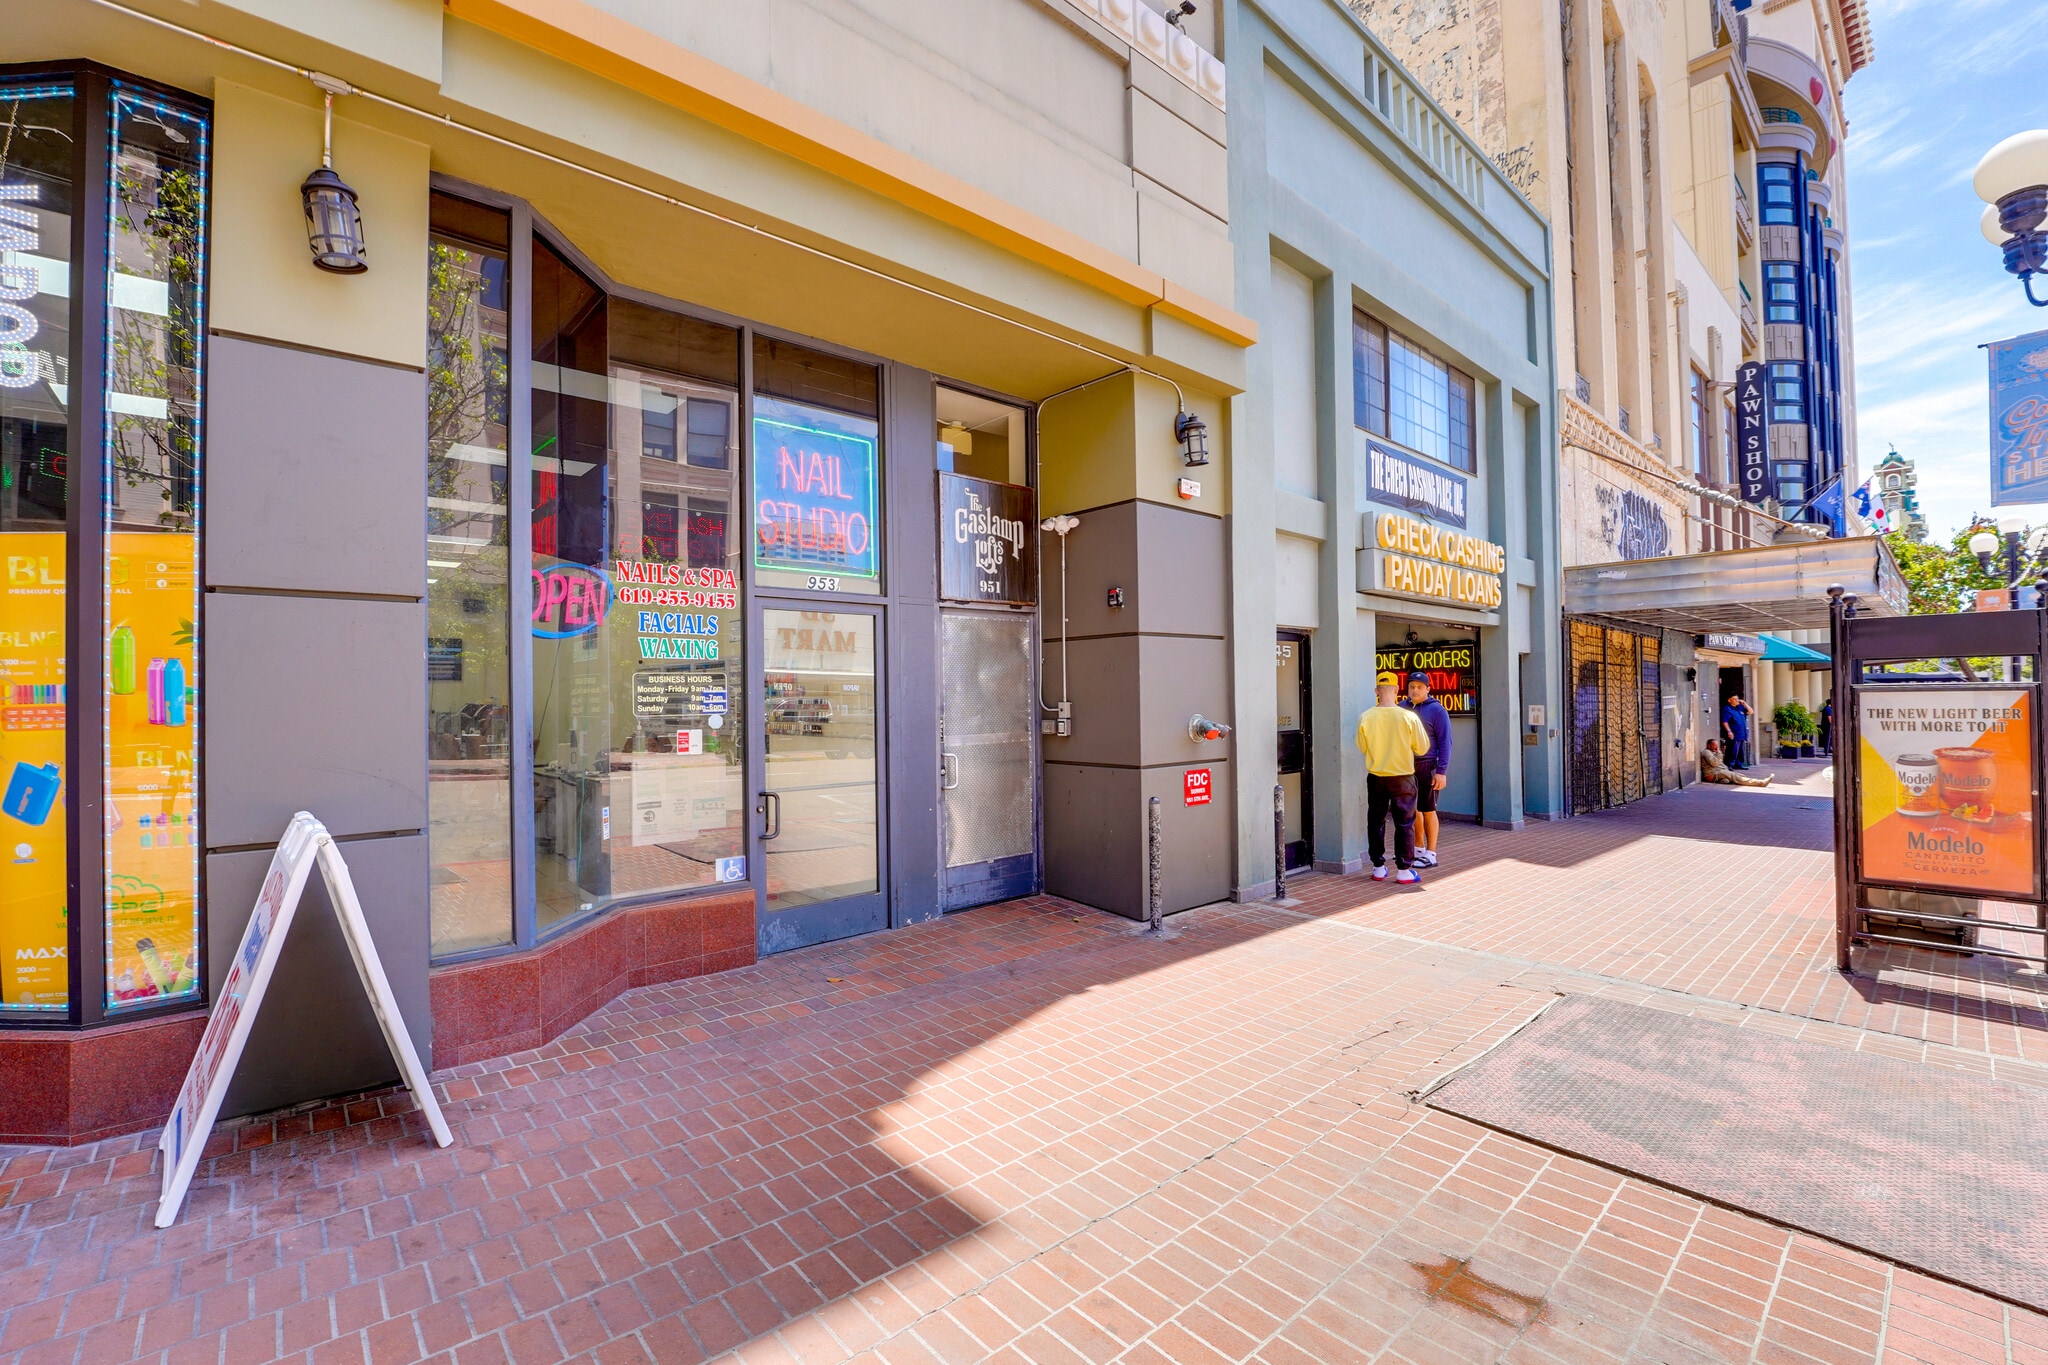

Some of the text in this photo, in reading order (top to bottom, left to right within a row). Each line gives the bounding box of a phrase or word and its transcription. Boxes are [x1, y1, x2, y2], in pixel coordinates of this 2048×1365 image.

[1741, 368, 1760, 429] PAWN
[781, 446, 853, 500] NAIL
[1745, 435, 1764, 498] SHOP
[1370, 449, 1384, 490] THE
[1385, 455, 1408, 498] CHECK
[1408, 464, 1436, 507] CASHING
[964, 487, 983, 512] The
[759, 499, 868, 555] STUDIO
[955, 507, 1025, 560] Gaslamp
[1378, 512, 1505, 574] CHECK CASHING
[975, 535, 1004, 574] Lofts
[616, 561, 737, 589] NAILS & SPA
[808, 576, 836, 591] 953
[1386, 555, 1502, 607] PAYDAY LOANS
[532, 569, 606, 626] OPEN
[619, 587, 737, 609] 619-255-9455
[980, 580, 1000, 594] 951
[638, 611, 718, 635] FACIALS
[638, 637, 719, 660] WAXING
[1709, 634, 1723, 645] PAWN
[1723, 635, 1738, 647] SHOP
[1376, 649, 1470, 670] ONEY ORDERS
[1427, 672, 1457, 690] ATM
[637, 695, 668, 703] Saturday
[637, 705, 663, 713] Sunday
[1867, 708, 2022, 719] THE NEW LIGHT BEER
[1880, 721, 2007, 733] WITH MORE TO IT
[136, 750, 193, 769] BLN
[1187, 773, 1208, 787] FDC
[1898, 771, 1937, 784] Modelo
[1941, 772, 1991, 786] Modelo
[1908, 831, 1984, 855] Modelo
[1905, 852, 1985, 865] CANTARITO
[1913, 864, 1978, 876] CERVEZA
